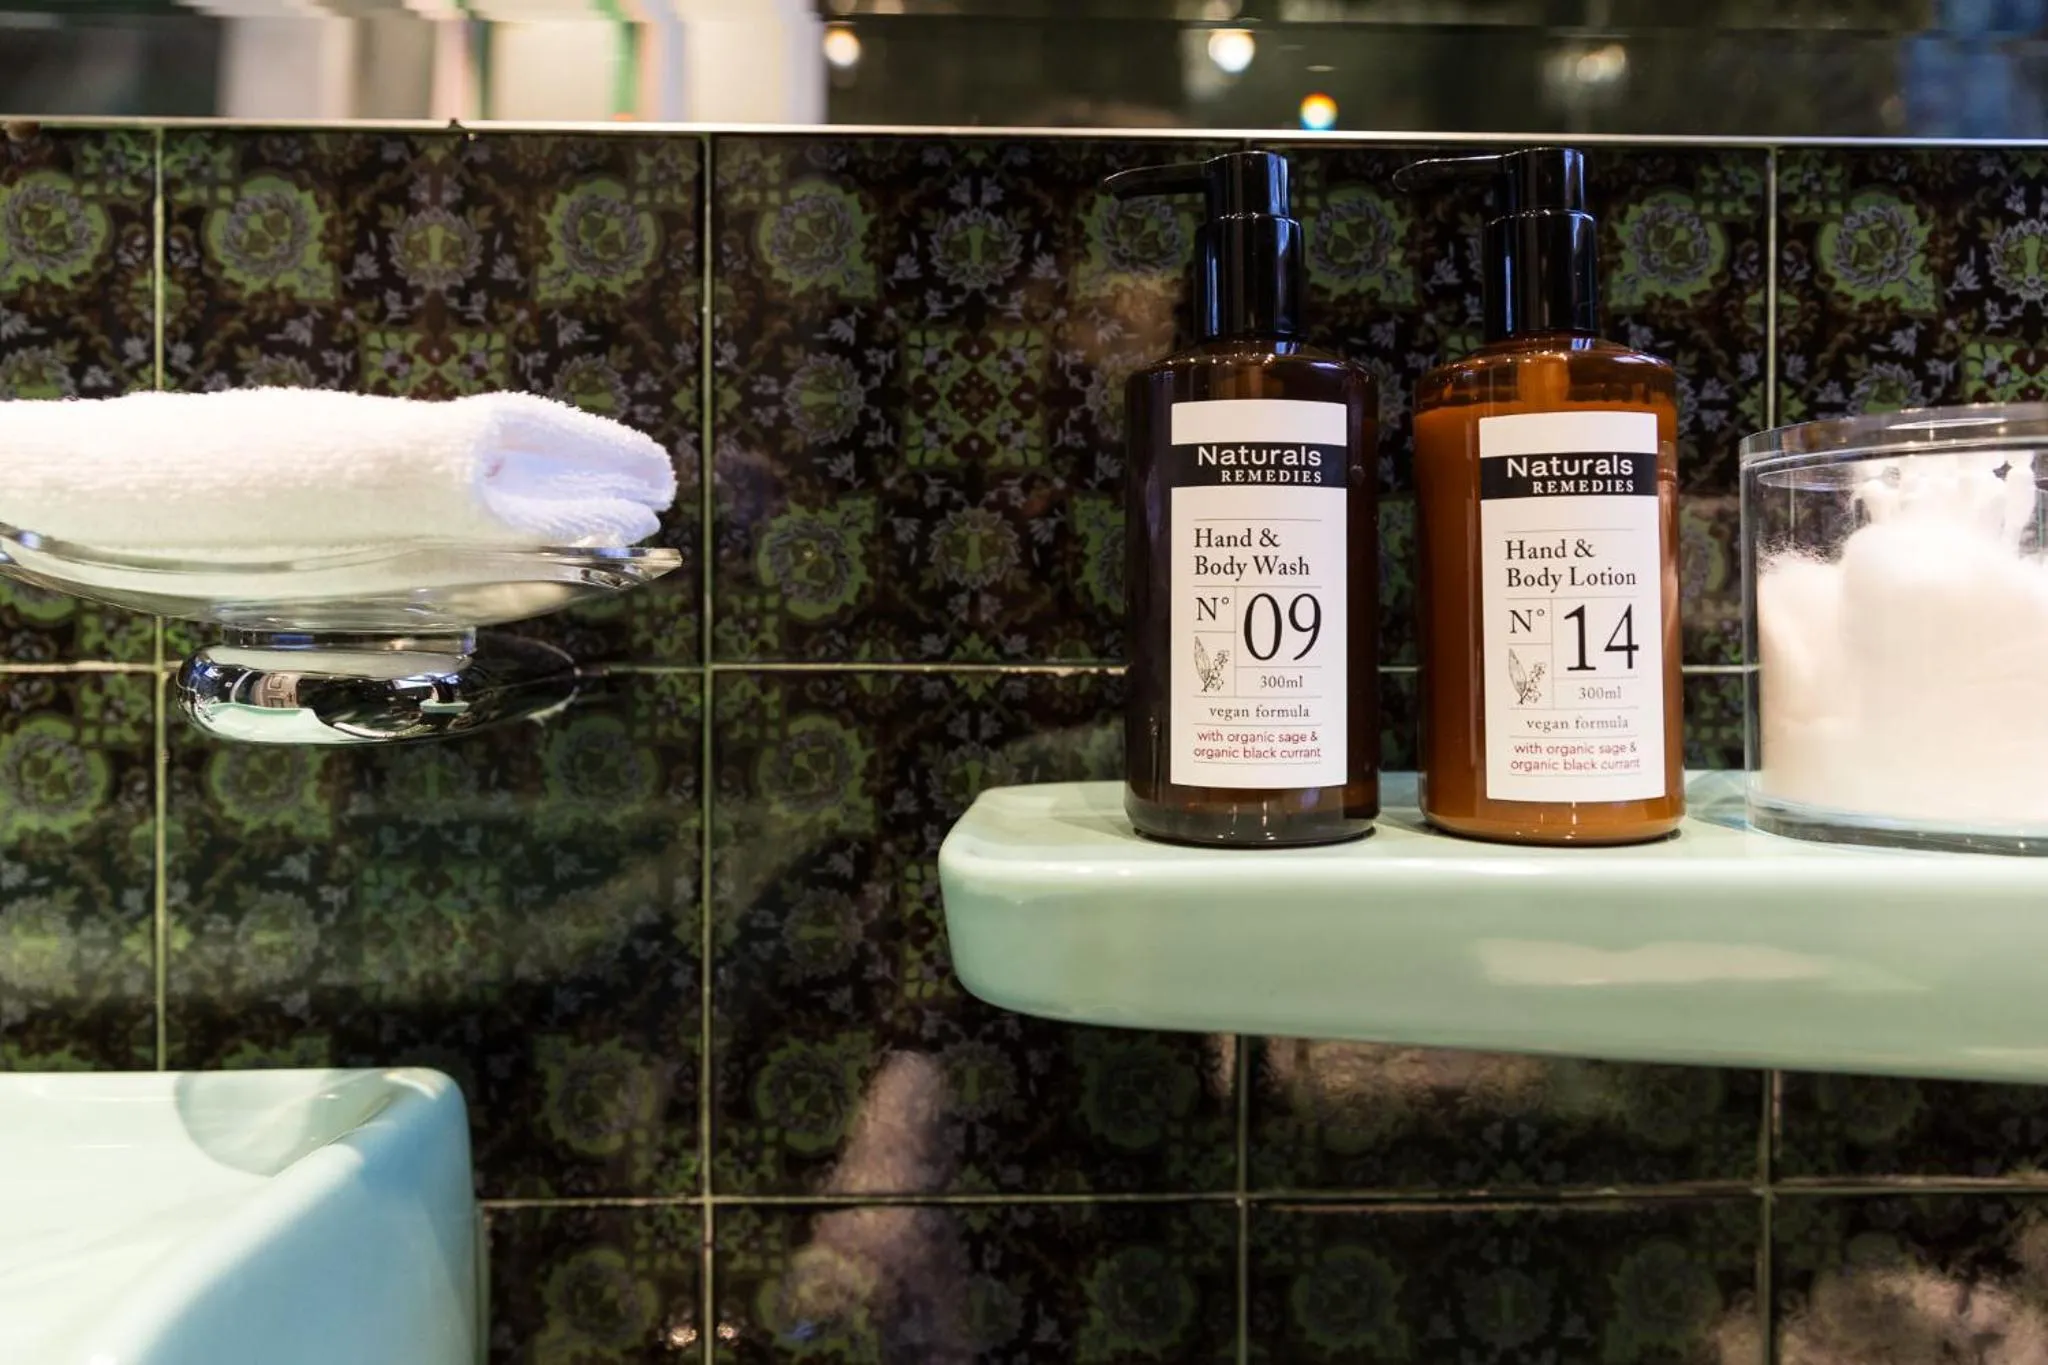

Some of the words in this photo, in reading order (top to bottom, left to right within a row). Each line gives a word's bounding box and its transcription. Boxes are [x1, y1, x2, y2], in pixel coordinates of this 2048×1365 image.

[1197, 445, 1322, 466] Naturals
[1507, 455, 1633, 478] Naturals
[1221, 469, 1322, 483] REMEDIES
[1532, 480, 1634, 494] REMEDIES
[1194, 527, 1252, 548] Hand
[1259, 527, 1281, 548] &
[1505, 539, 1567, 560] Hand
[1574, 538, 1596, 558] &
[1194, 555, 1247, 582] Body
[1252, 555, 1310, 576] Wash
[1505, 567, 1562, 593] Body
[1569, 565, 1637, 586] Lotion
[1243, 592, 1322, 661] 09
[1563, 603, 1639, 671] 14
[1259, 675, 1304, 689] 300ml
[1578, 686, 1622, 700] 300ml
[1209, 706, 1250, 721] vegan
[1255, 703, 1311, 718] formula
[1526, 718, 1569, 733] vegan
[1574, 715, 1629, 730] formula
[1197, 730, 1223, 742] with
[1226, 730, 1275, 744] organic
[1278, 733, 1307, 744] sage
[1310, 730, 1318, 742] &
[1193, 746, 1240, 760] organic
[1243, 746, 1277, 758] black
[1280, 747, 1321, 758] currant
[1514, 741, 1543, 754] with
[1546, 742, 1594, 757] organic
[1599, 744, 1627, 755] sage
[1510, 757, 1559, 772] organic
[1563, 757, 1598, 770] black
[1601, 758, 1640, 769] currant
